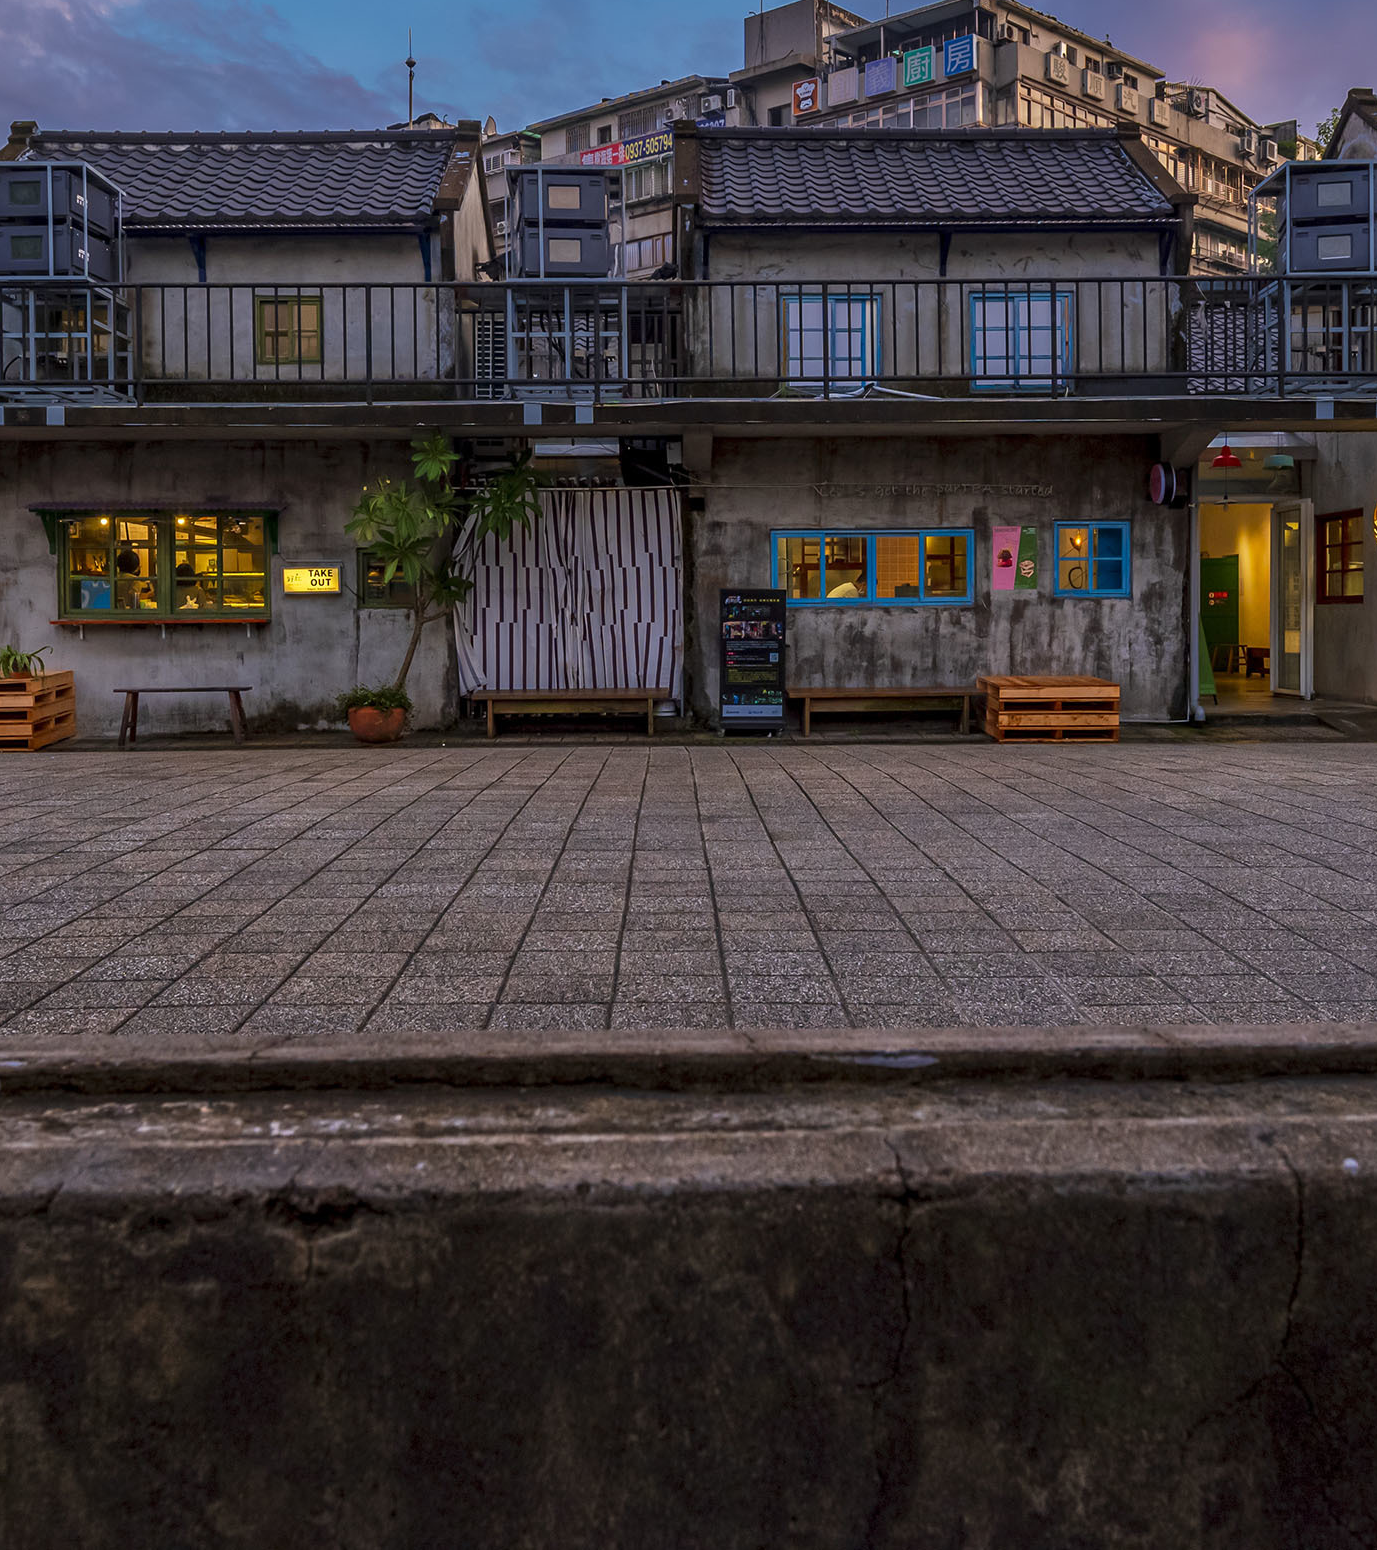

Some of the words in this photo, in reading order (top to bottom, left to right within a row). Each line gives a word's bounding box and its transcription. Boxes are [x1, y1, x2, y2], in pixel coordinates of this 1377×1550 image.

[625, 132, 673, 160] 0937-505794
[308, 569, 333, 577] TAKE
[310, 578, 331, 586] OUT
